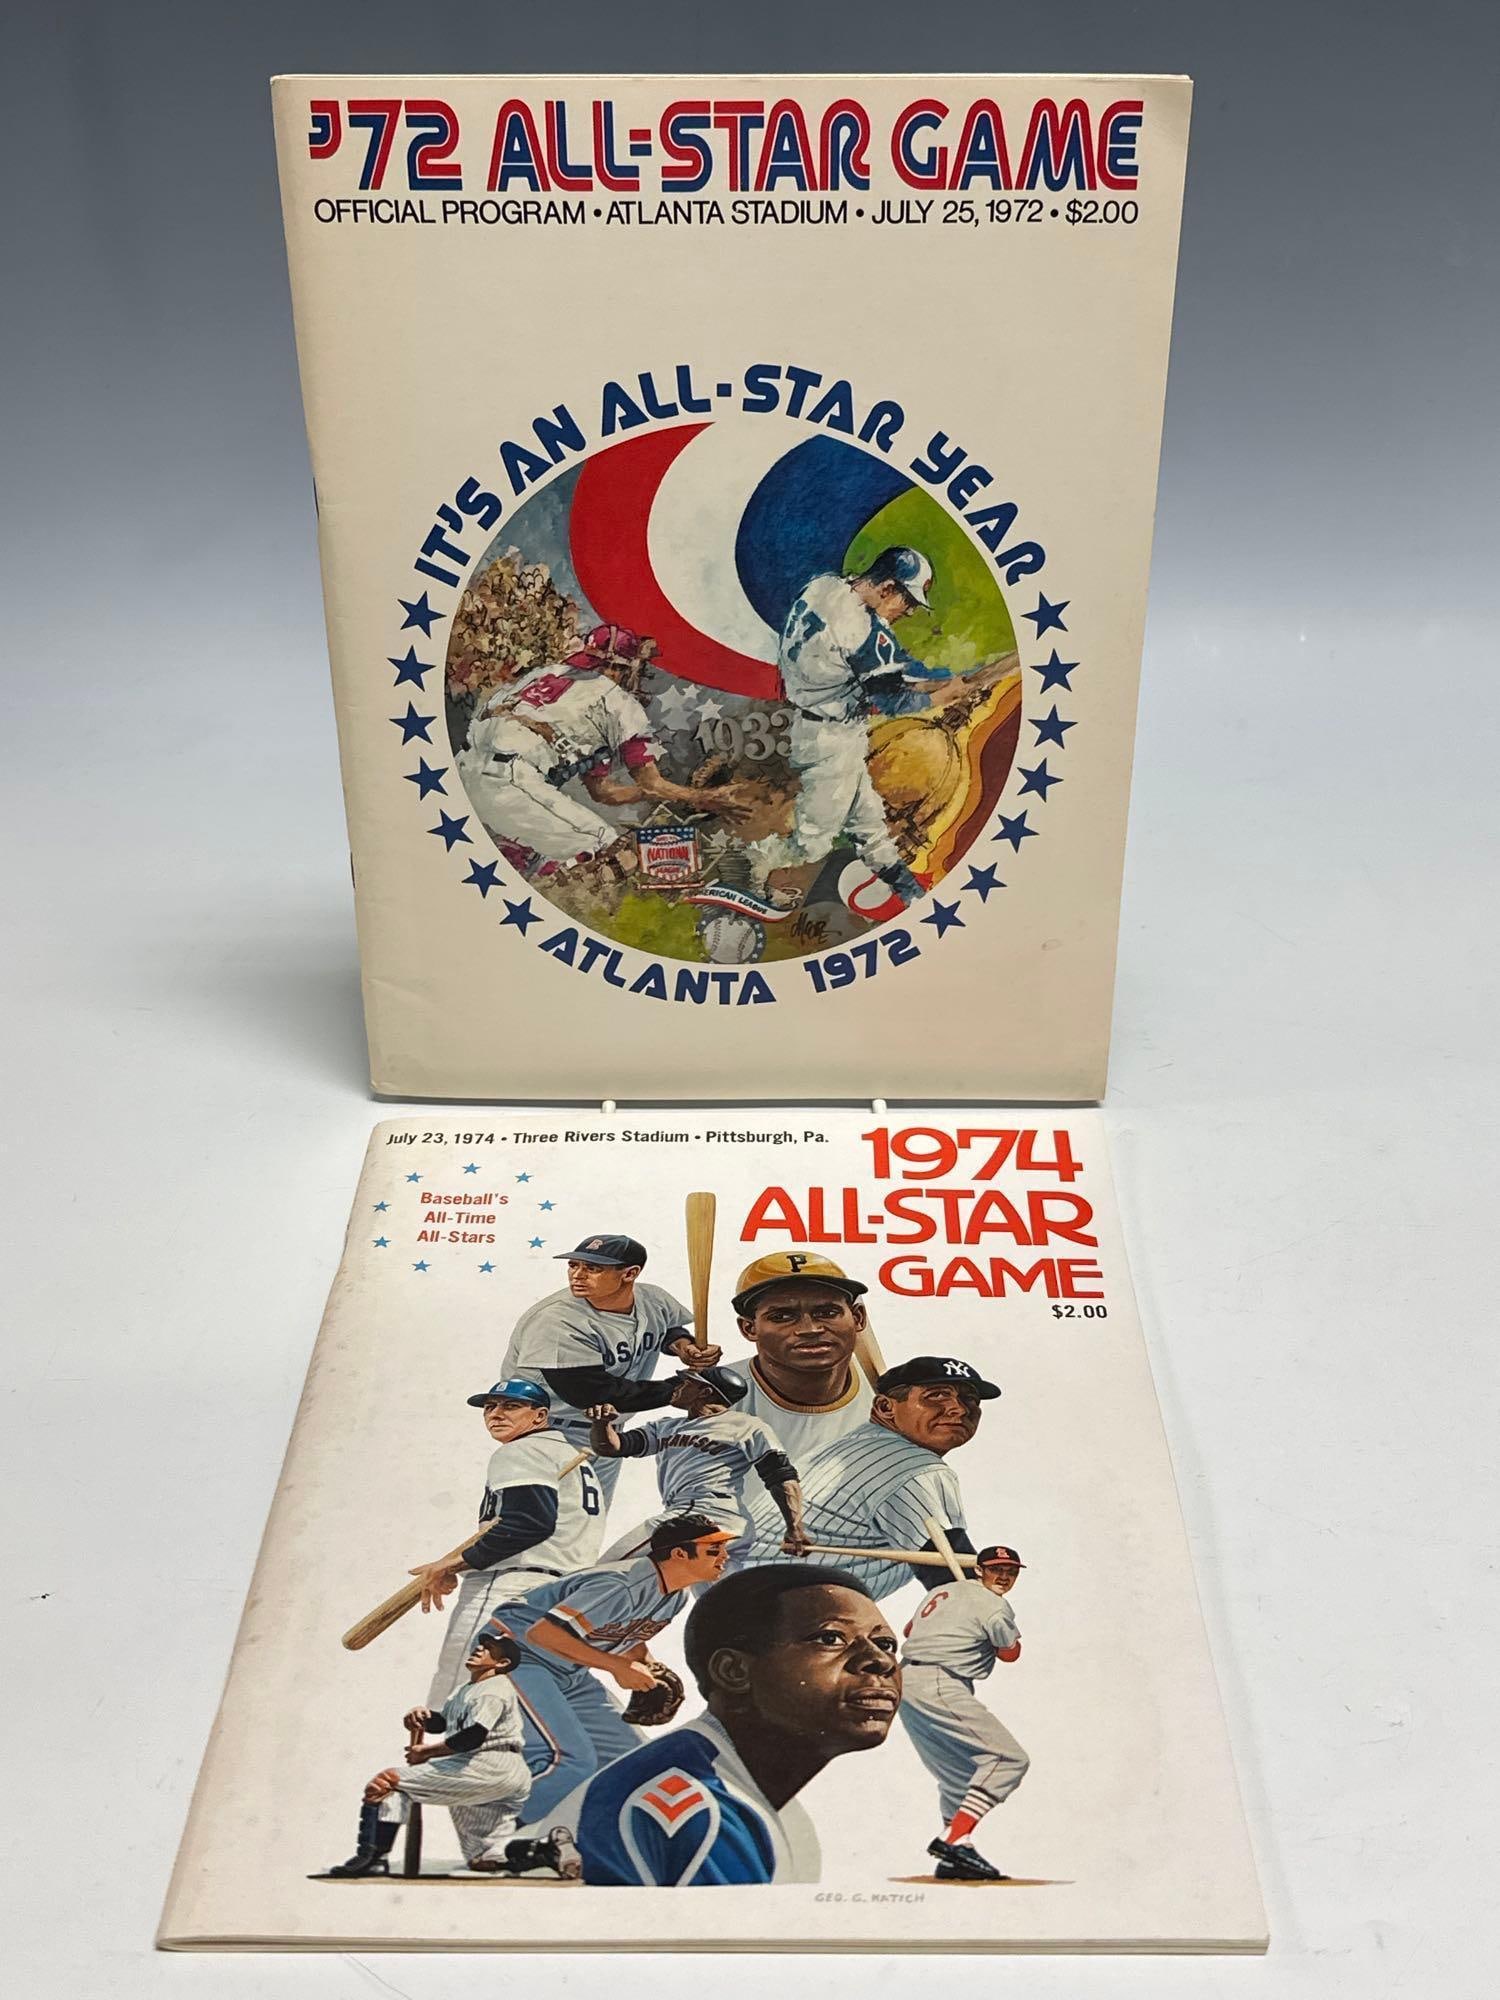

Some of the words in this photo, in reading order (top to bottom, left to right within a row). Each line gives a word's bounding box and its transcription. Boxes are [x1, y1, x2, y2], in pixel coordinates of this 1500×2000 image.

[308, 99, 463, 191] '72
[486, 98, 871, 193] ALL-STAR
[890, 98, 1144, 192] GAME
[313, 199, 436, 224] OFFICIAL
[442, 200, 586, 225] PROGRAM
[606, 200, 725, 225] ATLANTA
[730, 199, 848, 225] STADIUM
[871, 199, 934, 224] JULY
[1065, 198, 1139, 225] $2.00
[413, 475, 503, 589] IT'S
[499, 403, 587, 497] AN
[908, 430, 1047, 587] YEAR
[537, 927, 777, 1006] ATLANTA
[803, 928, 923, 994] 1972
[386, 1131, 418, 1146] July
[421, 1132, 450, 1147] 23,
[453, 1132, 496, 1146] 1974
[512, 1131, 559, 1144] Three
[564, 1130, 616, 1143] Rivers
[621, 1130, 690, 1143] Stadium
[705, 1130, 798, 1145] Pittsburgh,
[803, 1130, 829, 1144] Pa.
[861, 1127, 1084, 1183] 1974
[420, 1191, 509, 1206] Baseball's
[423, 1210, 497, 1225] All-Time
[739, 1186, 1099, 1248] ALL-STAR
[416, 1229, 496, 1244] All-Stars
[786, 1253, 807, 1273] P
[878, 1255, 1105, 1299] GAME
[1051, 1303, 1108, 1320] $2.00
[579, 1463, 600, 1516] 6
